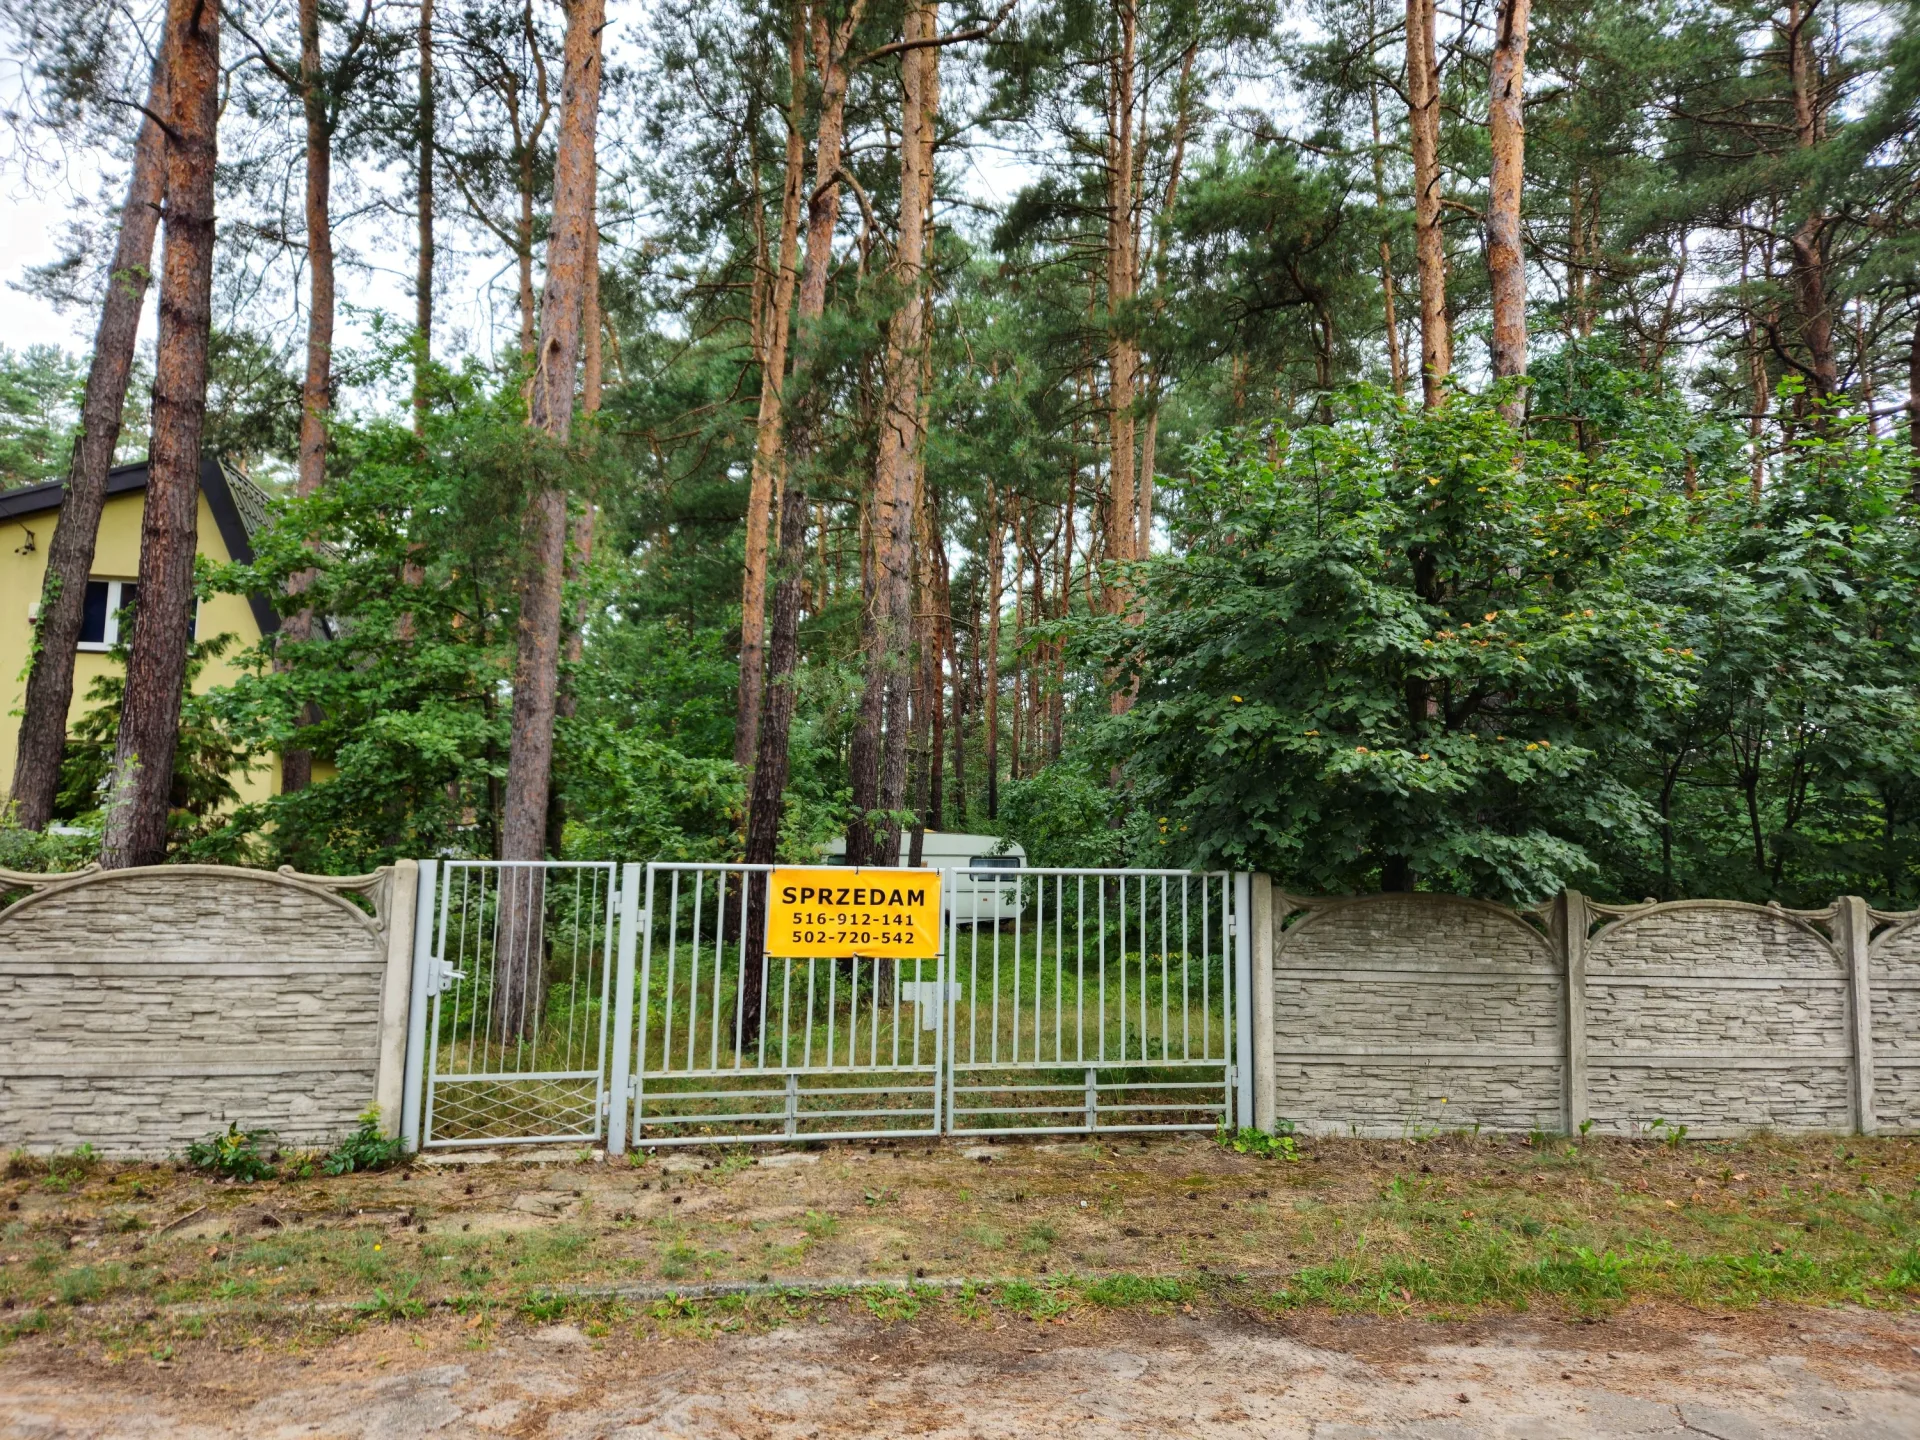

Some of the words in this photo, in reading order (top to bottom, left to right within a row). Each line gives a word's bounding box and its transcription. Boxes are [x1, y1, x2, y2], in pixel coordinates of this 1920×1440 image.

[782, 887, 925, 906] SPRZEDAM
[792, 912, 914, 926] 516-912-141
[792, 931, 915, 944] 502-720-542
